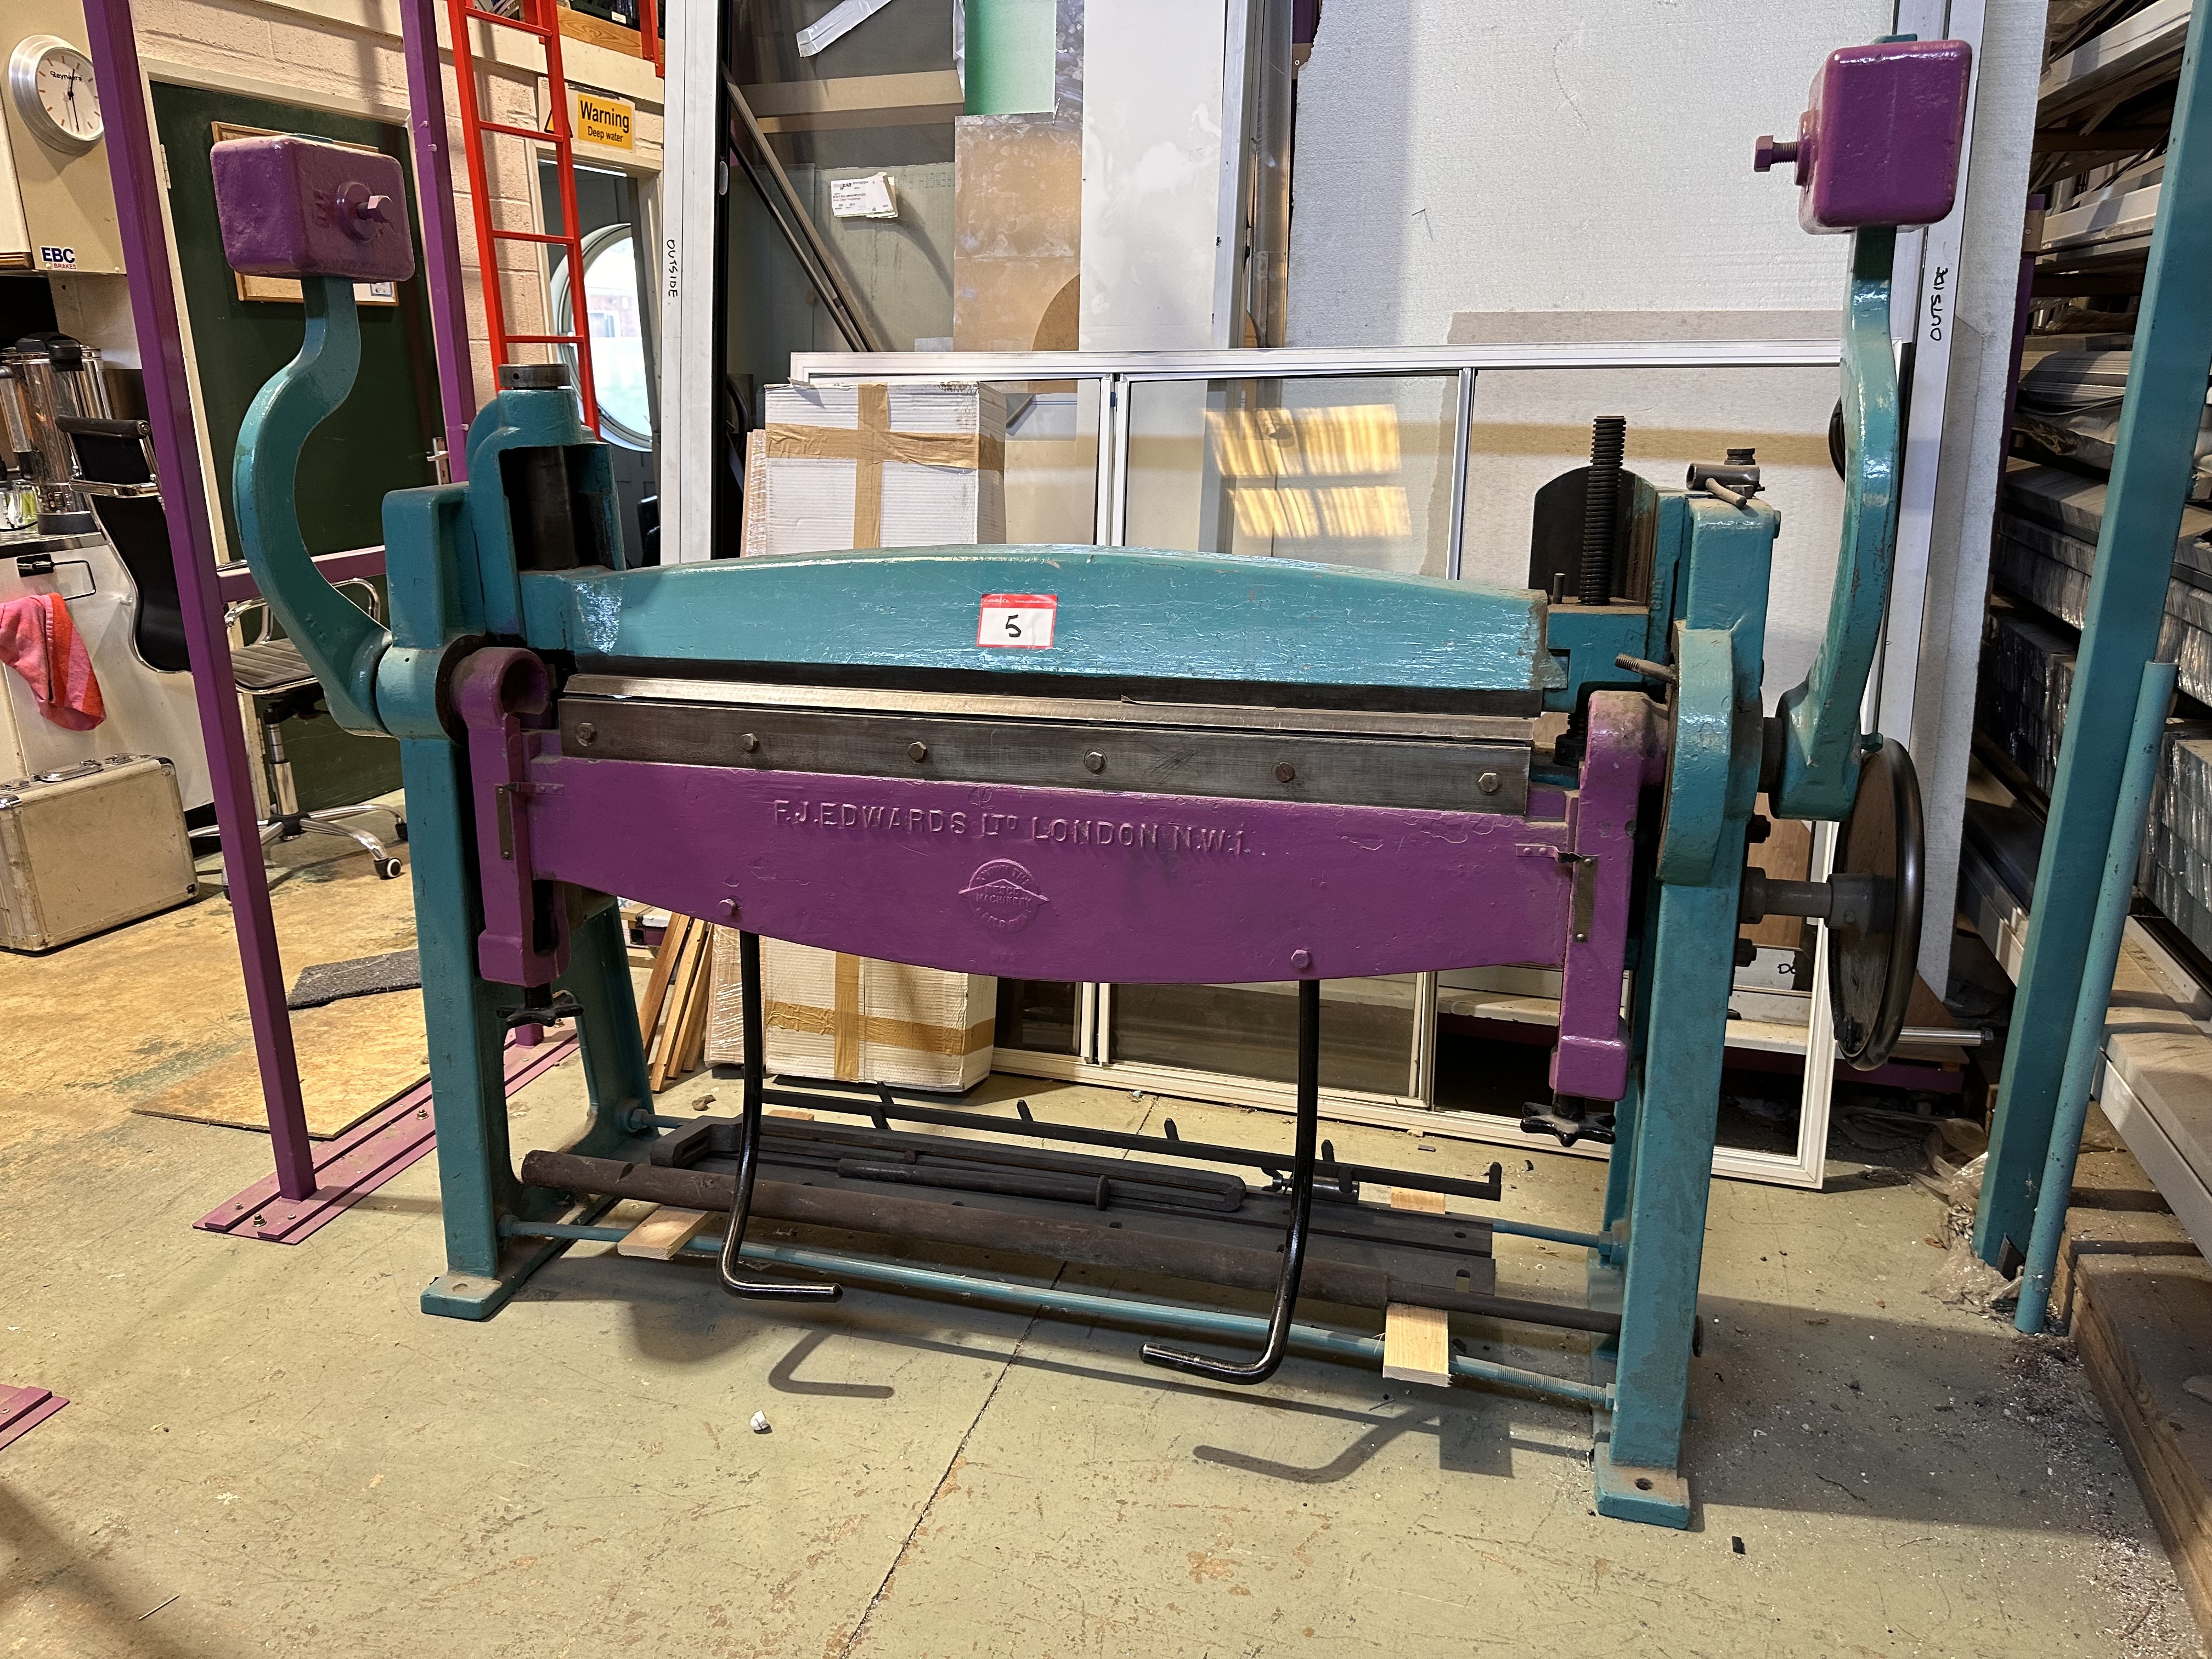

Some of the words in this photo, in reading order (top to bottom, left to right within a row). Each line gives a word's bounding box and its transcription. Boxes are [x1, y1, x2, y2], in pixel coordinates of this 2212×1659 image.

[580, 100, 630, 133] Warning
[588, 126, 604, 140] Deep
[606, 132, 623, 142] water
[41, 247, 75, 263] EBC
[667, 239, 678, 297] OUTSIDE
[1930, 267, 1949, 341] OUTSIDE
[1005, 614, 1022, 637] 5
[1032, 816, 1159, 850] LONDON
